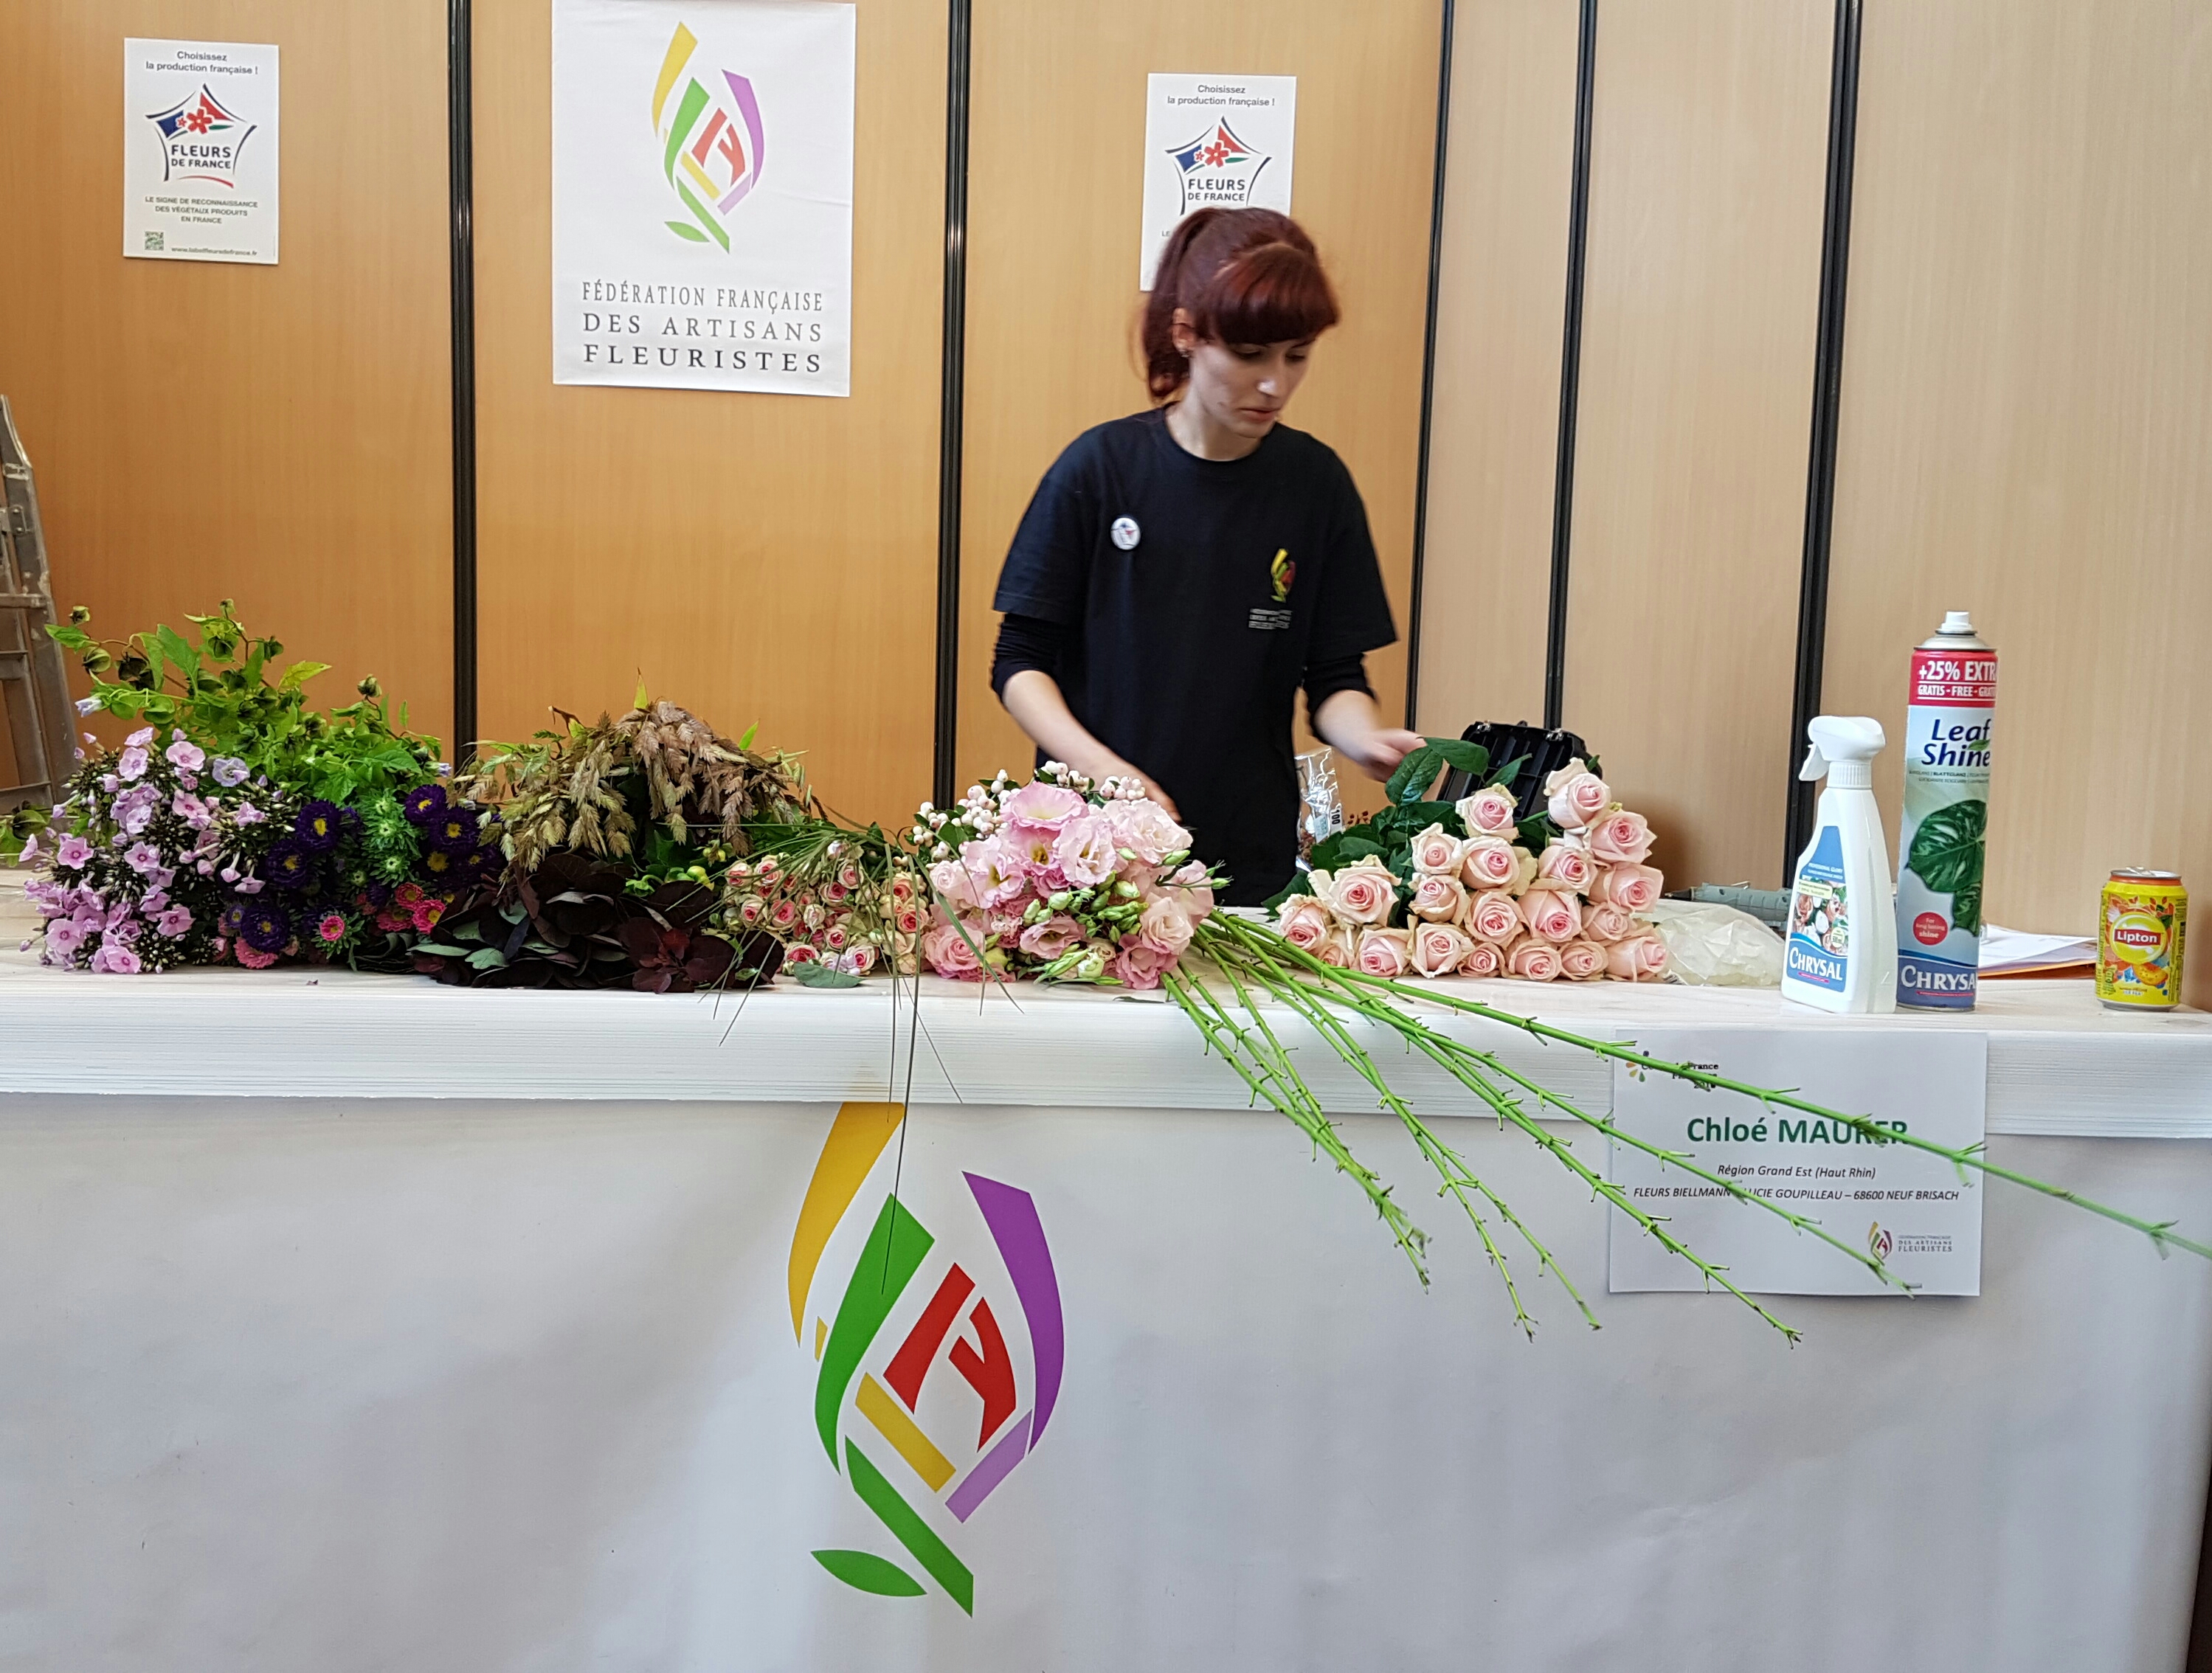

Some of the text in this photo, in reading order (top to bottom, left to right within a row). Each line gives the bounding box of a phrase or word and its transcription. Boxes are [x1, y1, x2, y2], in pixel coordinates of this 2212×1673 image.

[176, 51, 227, 61] Choisissez
[146, 61, 154, 69] la
[156, 62, 207, 72] production
[210, 64, 252, 75] française
[1197, 84, 1245, 94] Choisissez
[1167, 96, 1175, 104] la
[1178, 96, 1226, 105] production
[1228, 97, 1270, 107] française
[171, 145, 231, 158] FLEURS
[171, 159, 231, 169] DE FRANCE
[1188, 179, 1245, 190] FLEURS
[1187, 193, 1245, 201] DE FRANCE
[582, 279, 822, 314] FÉDÉRATION FRANÇAISE
[583, 313, 820, 342] DES ARTISANS
[584, 344, 820, 373] FLEURISTES
[1919, 660, 1960, 681] +25%
[1918, 685, 1945, 696] GRATIS
[1951, 685, 1974, 696] FREE
[1931, 718, 1991, 741] Leaf
[1921, 743, 1991, 766] Shine
[1331, 809, 1341, 825] 100
[2117, 930, 2157, 943] Lipton
[1789, 946, 1843, 981] CHRYSAL
[1687, 1117, 1768, 1143] Chloé
[1718, 1165, 1876, 1180] Région Grand Est (Haut Rhin)
[1634, 1188, 1670, 1197] FLEURS
[1673, 1188, 1730, 1197] BIELLMANN
[1775, 1188, 1842, 1199] GOUPILLEAU
[1853, 1190, 1884, 1200] 68600
[1886, 1191, 1914, 1200] NEUF
[1915, 1191, 1959, 1200] BRISACH
